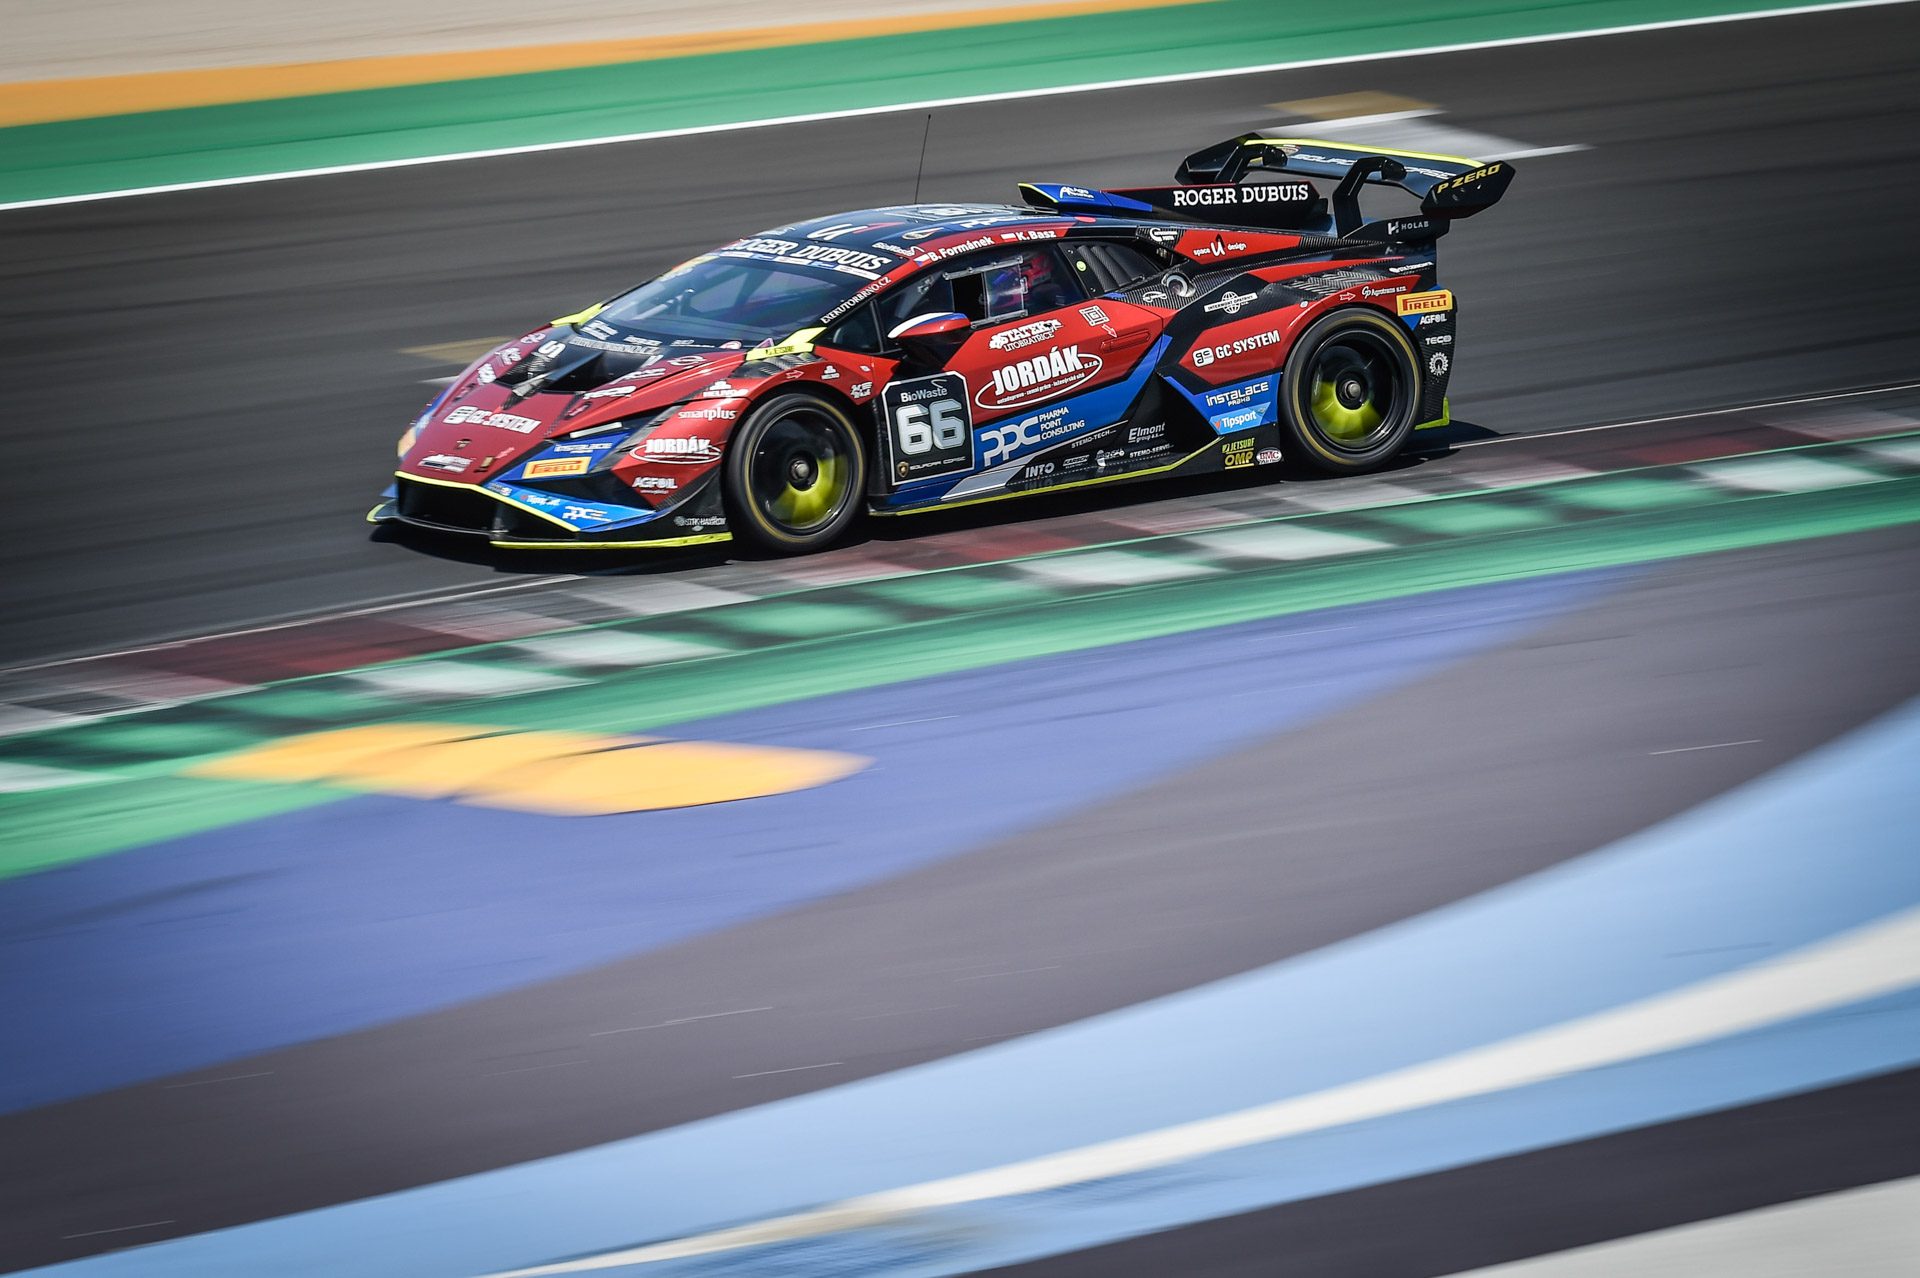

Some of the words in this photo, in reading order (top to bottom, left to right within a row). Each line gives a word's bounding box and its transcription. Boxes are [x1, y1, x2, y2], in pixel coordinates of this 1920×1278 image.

[1437, 181, 1449, 194] P
[1451, 164, 1502, 189] ZERO
[1173, 187, 1237, 206] ROGER
[1242, 184, 1309, 203] DUBUIS
[1401, 220, 1430, 230] HOLAB
[1029, 230, 1057, 240] Basz
[929, 251, 942, 262] B.
[940, 236, 995, 259] Formánek
[1227, 242, 1247, 251] design
[791, 244, 893, 270] DUBUIS
[819, 276, 892, 325] EXEKUTORBRNO.CZ
[1402, 294, 1447, 312] PIRELLI
[1419, 313, 1447, 326] AGFOIL
[1215, 344, 1233, 360] GC
[1233, 330, 1281, 354] SYSTEM
[1425, 335, 1452, 345] TECO
[992, 344, 1084, 396] JORDÁK
[1083, 360, 1100, 369] s.r.o.
[900, 387, 948, 403] BioWaste
[678, 407, 737, 421] smartplus
[1039, 406, 1070, 423] PHARMA
[1221, 410, 1257, 429] Tipsport
[895, 398, 966, 455] 66
[1040, 418, 1063, 432] POINT
[1040, 420, 1085, 441] CONSULTING
[1128, 422, 1166, 442] Elmont
[646, 436, 712, 456] JORDÁK
[980, 415, 1042, 468] PPC
[1071, 429, 1110, 449] STEMO-TECH
[1230, 438, 1256, 452] JETSURF
[1225, 451, 1254, 466] OMP
[1025, 462, 1055, 479] INTO
[632, 476, 678, 490] AGFOIL
